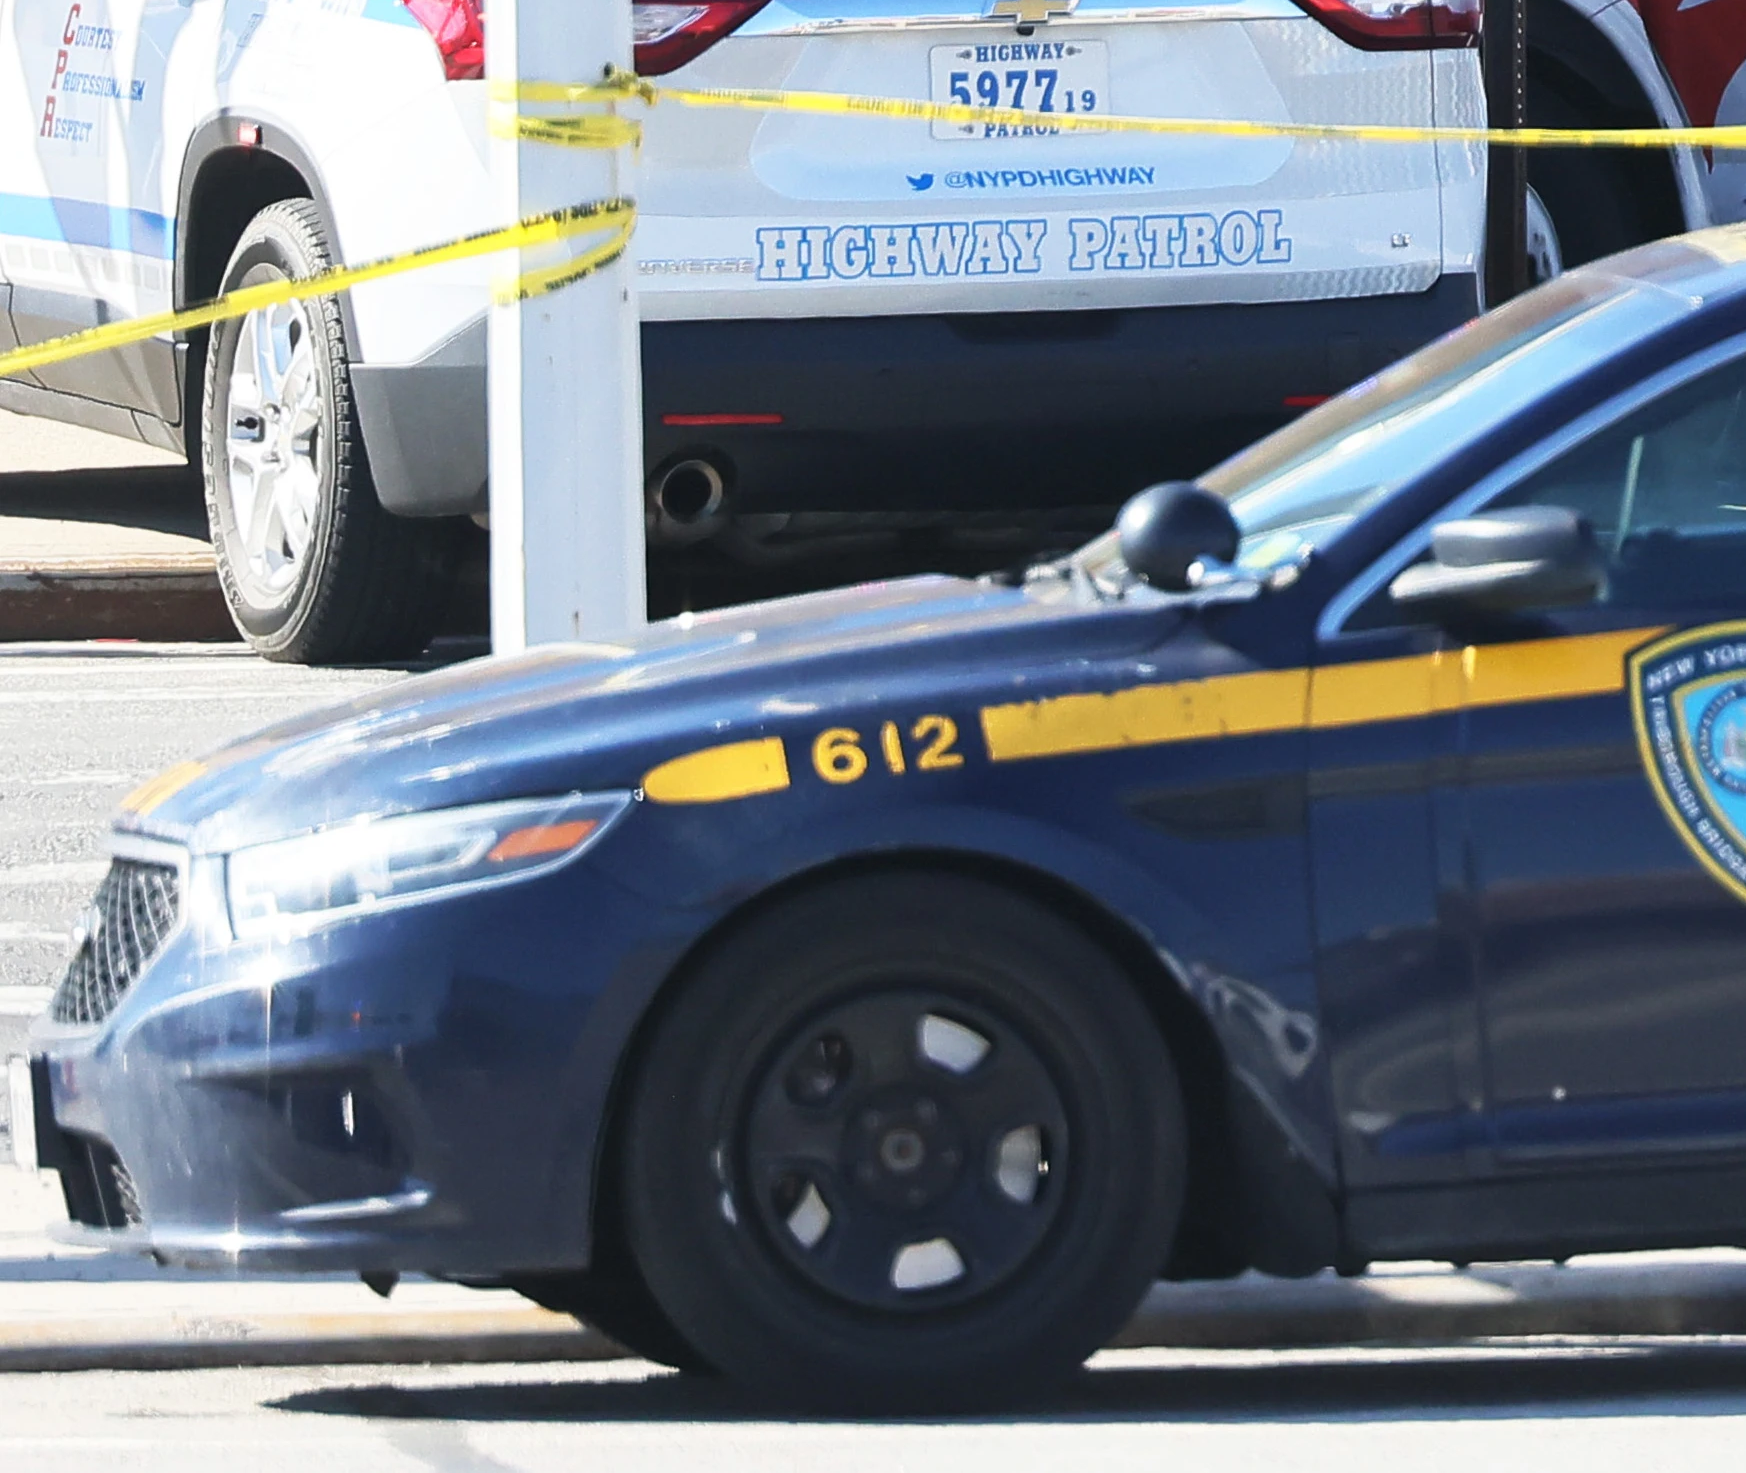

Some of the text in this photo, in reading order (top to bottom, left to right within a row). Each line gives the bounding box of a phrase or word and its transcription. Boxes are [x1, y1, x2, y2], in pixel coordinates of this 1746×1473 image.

[975, 43, 1065, 62] HIGHWAY
[949, 69, 1058, 112] 5977
[1065, 90, 1097, 112] 19
[944, 165, 1156, 190] @NYPDHIGHWAY
[756, 210, 1292, 281] HIGHWAY PATROL
[1648, 656, 1694, 690] NEW
[812, 715, 964, 784] 612
